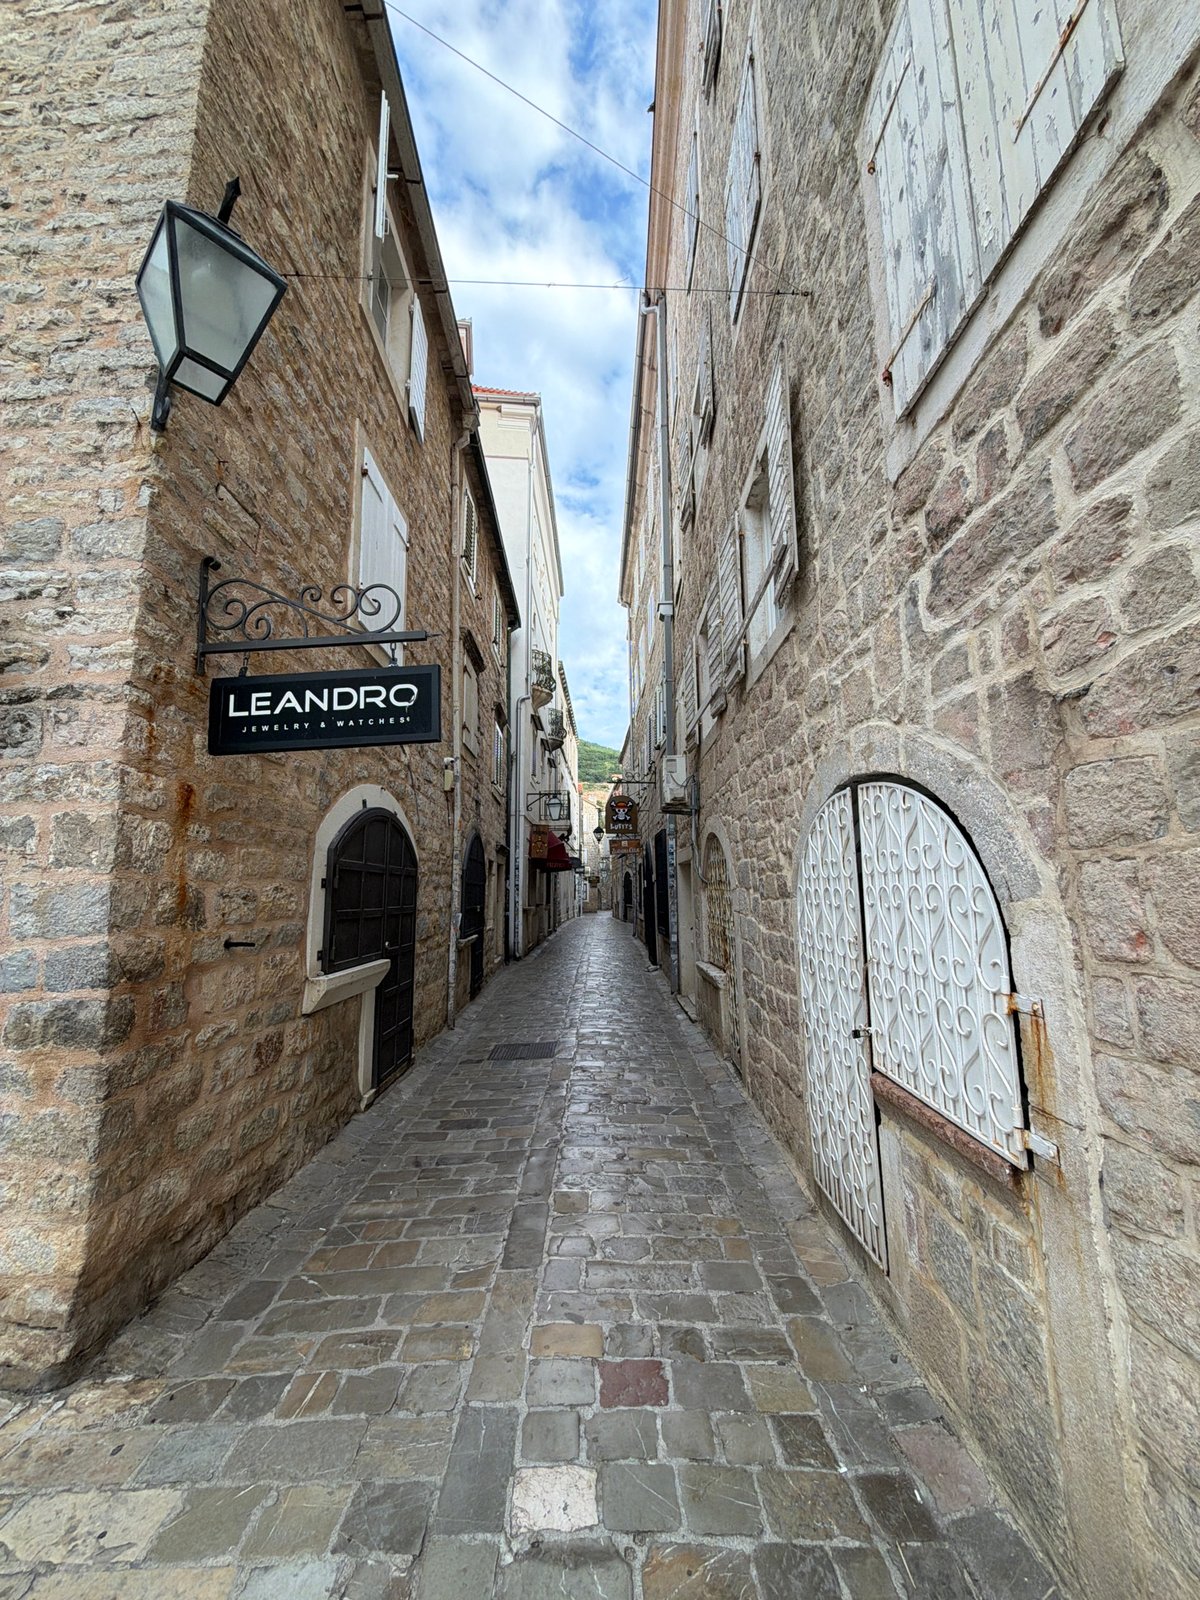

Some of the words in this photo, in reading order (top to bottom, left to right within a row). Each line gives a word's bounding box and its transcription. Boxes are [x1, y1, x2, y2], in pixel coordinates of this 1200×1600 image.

[228, 683, 418, 717] LEANDRO
[242, 722, 309, 733] JEWELRY
[337, 716, 405, 727] WATCHES
